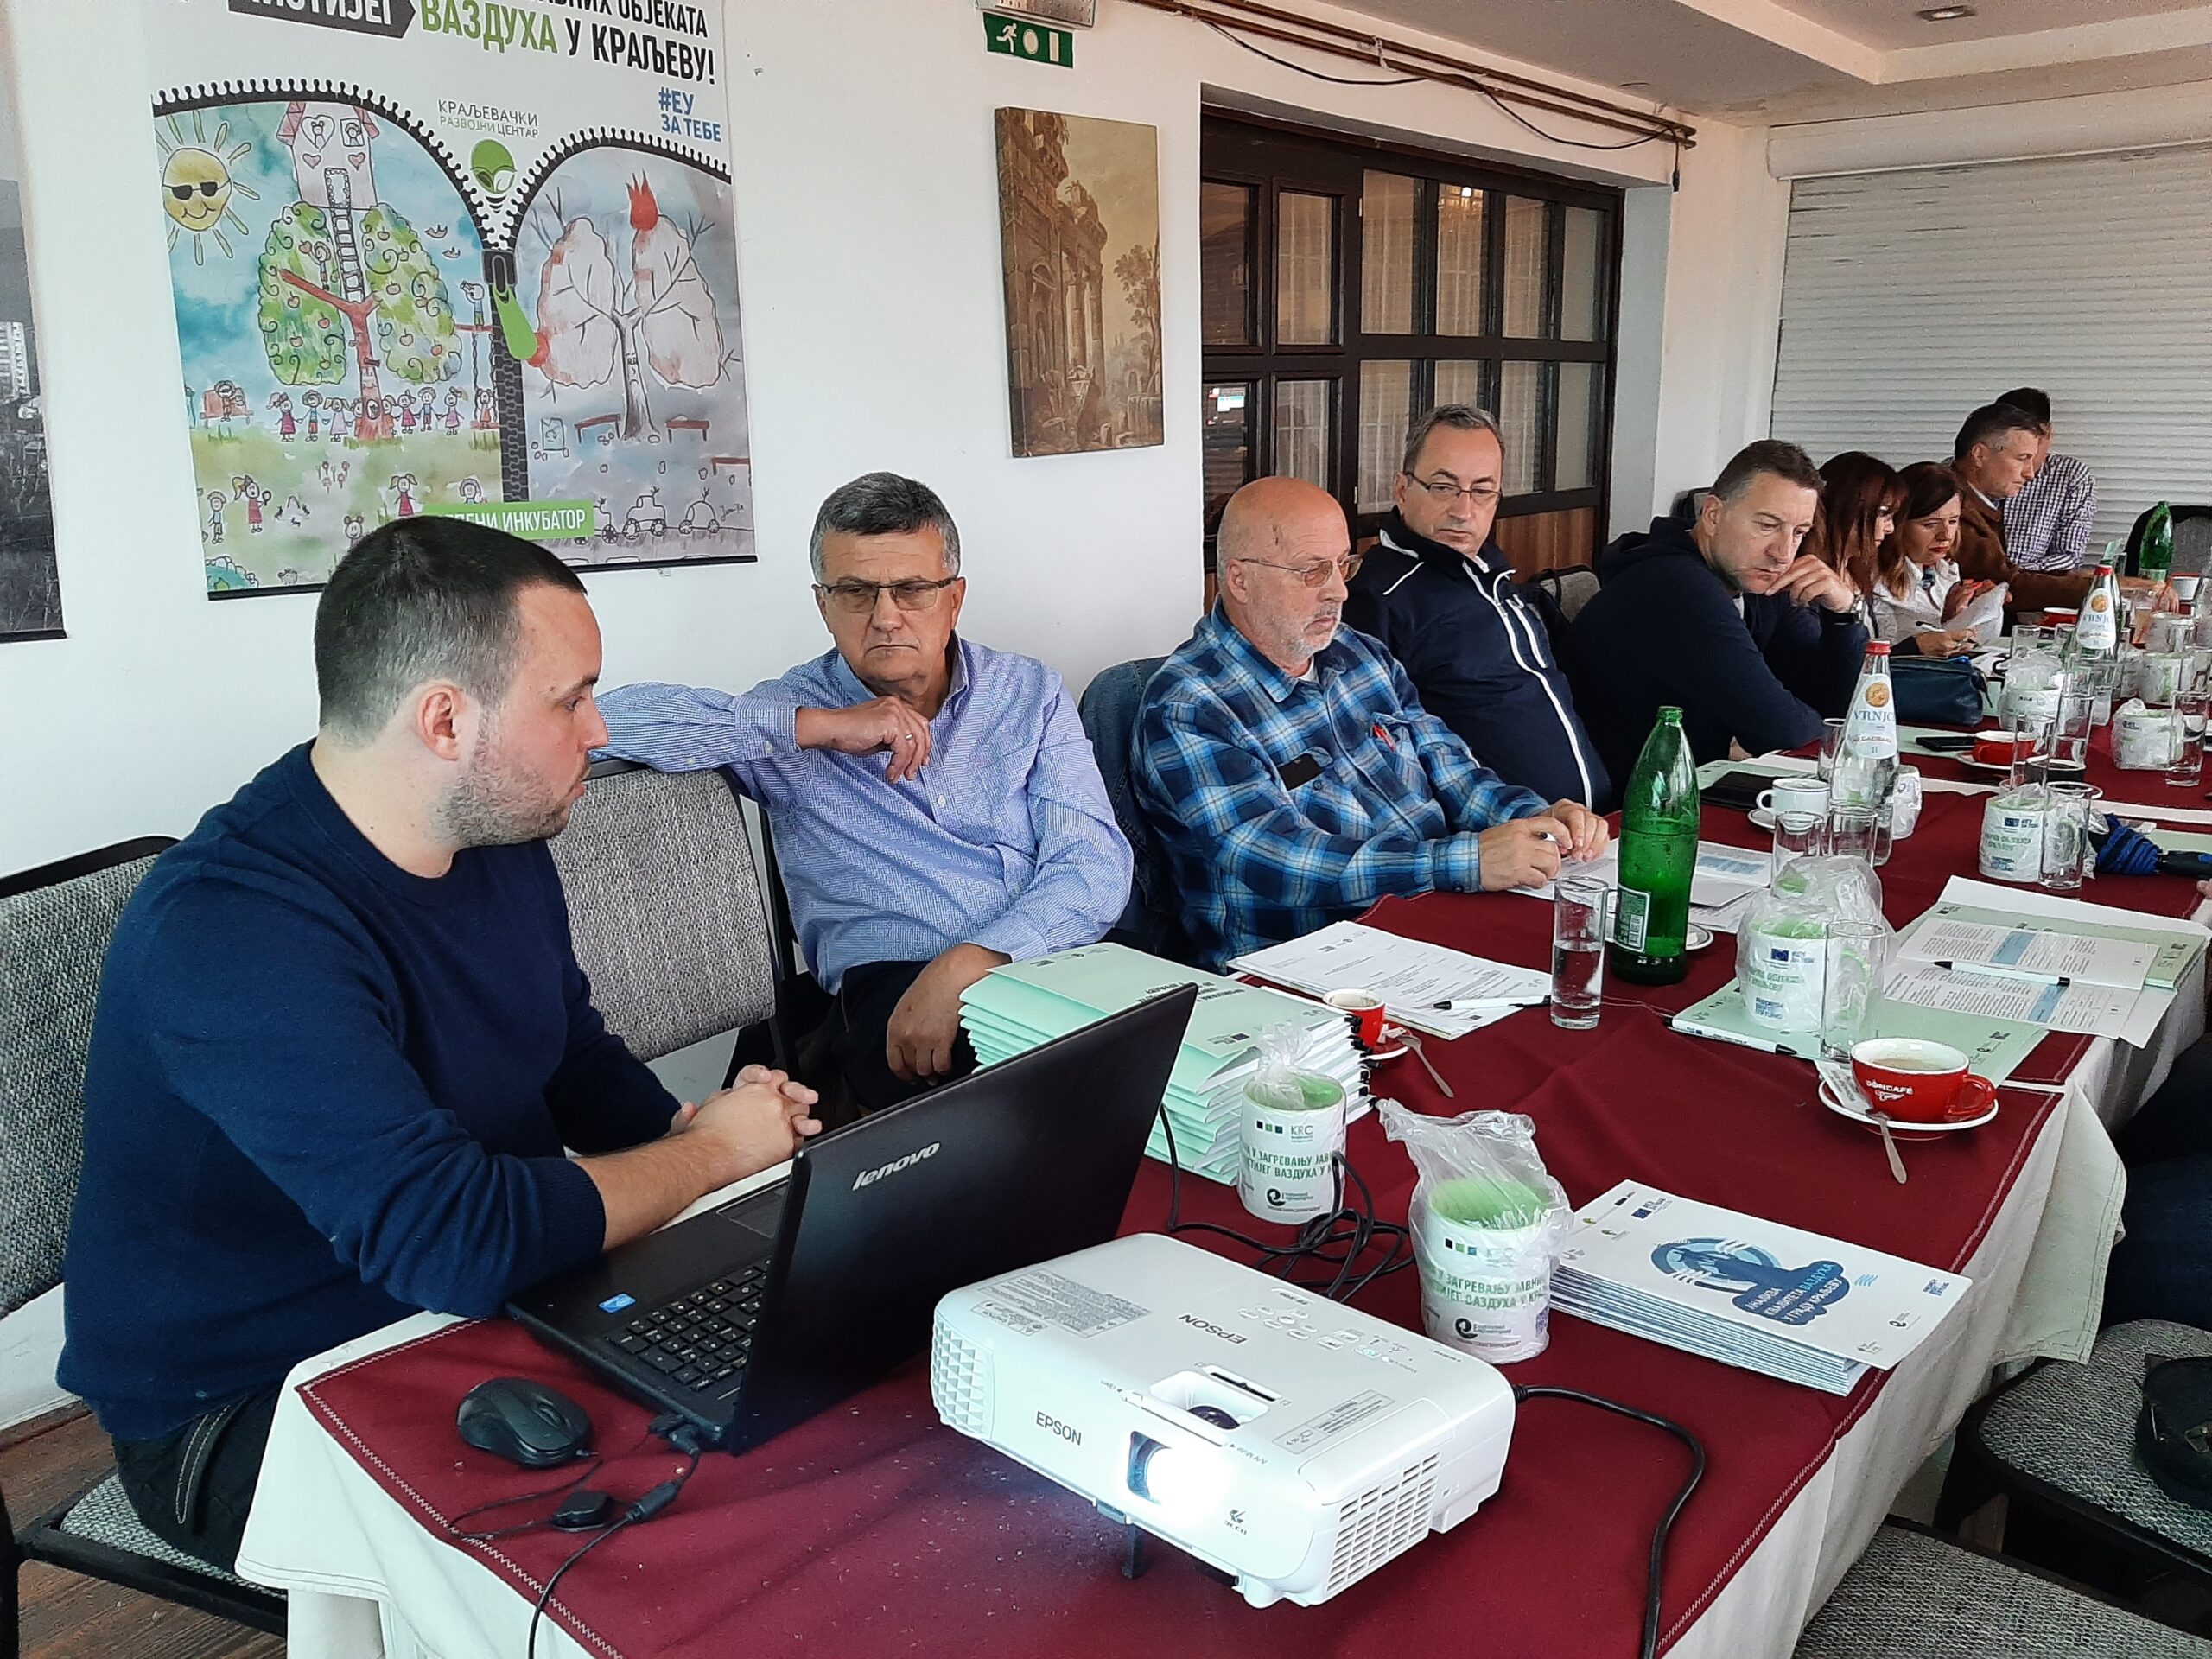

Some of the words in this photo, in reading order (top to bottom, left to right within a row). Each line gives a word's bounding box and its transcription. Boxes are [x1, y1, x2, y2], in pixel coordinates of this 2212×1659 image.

[618, 0, 709, 37] ОБЈЕКАТА
[251, 0, 392, 25] ИЈЕГ
[421, 1, 558, 54] ВАЗДУХА
[564, 17, 581, 56] У
[591, 22, 715, 85] КРАЉЕВУ!
[438, 99, 538, 127] КРАЉЕВАЧКИ
[658, 86, 694, 116] #ЕУ
[497, 124, 539, 138] ЦЕНТАР
[660, 113, 683, 135] ЗА
[683, 118, 722, 143] ТЕБЕ
[502, 508, 586, 533] ИНКУБАТОР
[1291, 1125, 1313, 1135] KRC
[852, 1142, 941, 1192] lenovo
[1258, 1150, 1313, 1167] ЗАГРЕВАЊУ
[1274, 1166, 1318, 1181] ВАЗДУХА
[1798, 1262, 1836, 1291] ВАЗДУХА
[1178, 1314, 1248, 1344] EPSON
[1036, 1410, 1082, 1446] EPSON
